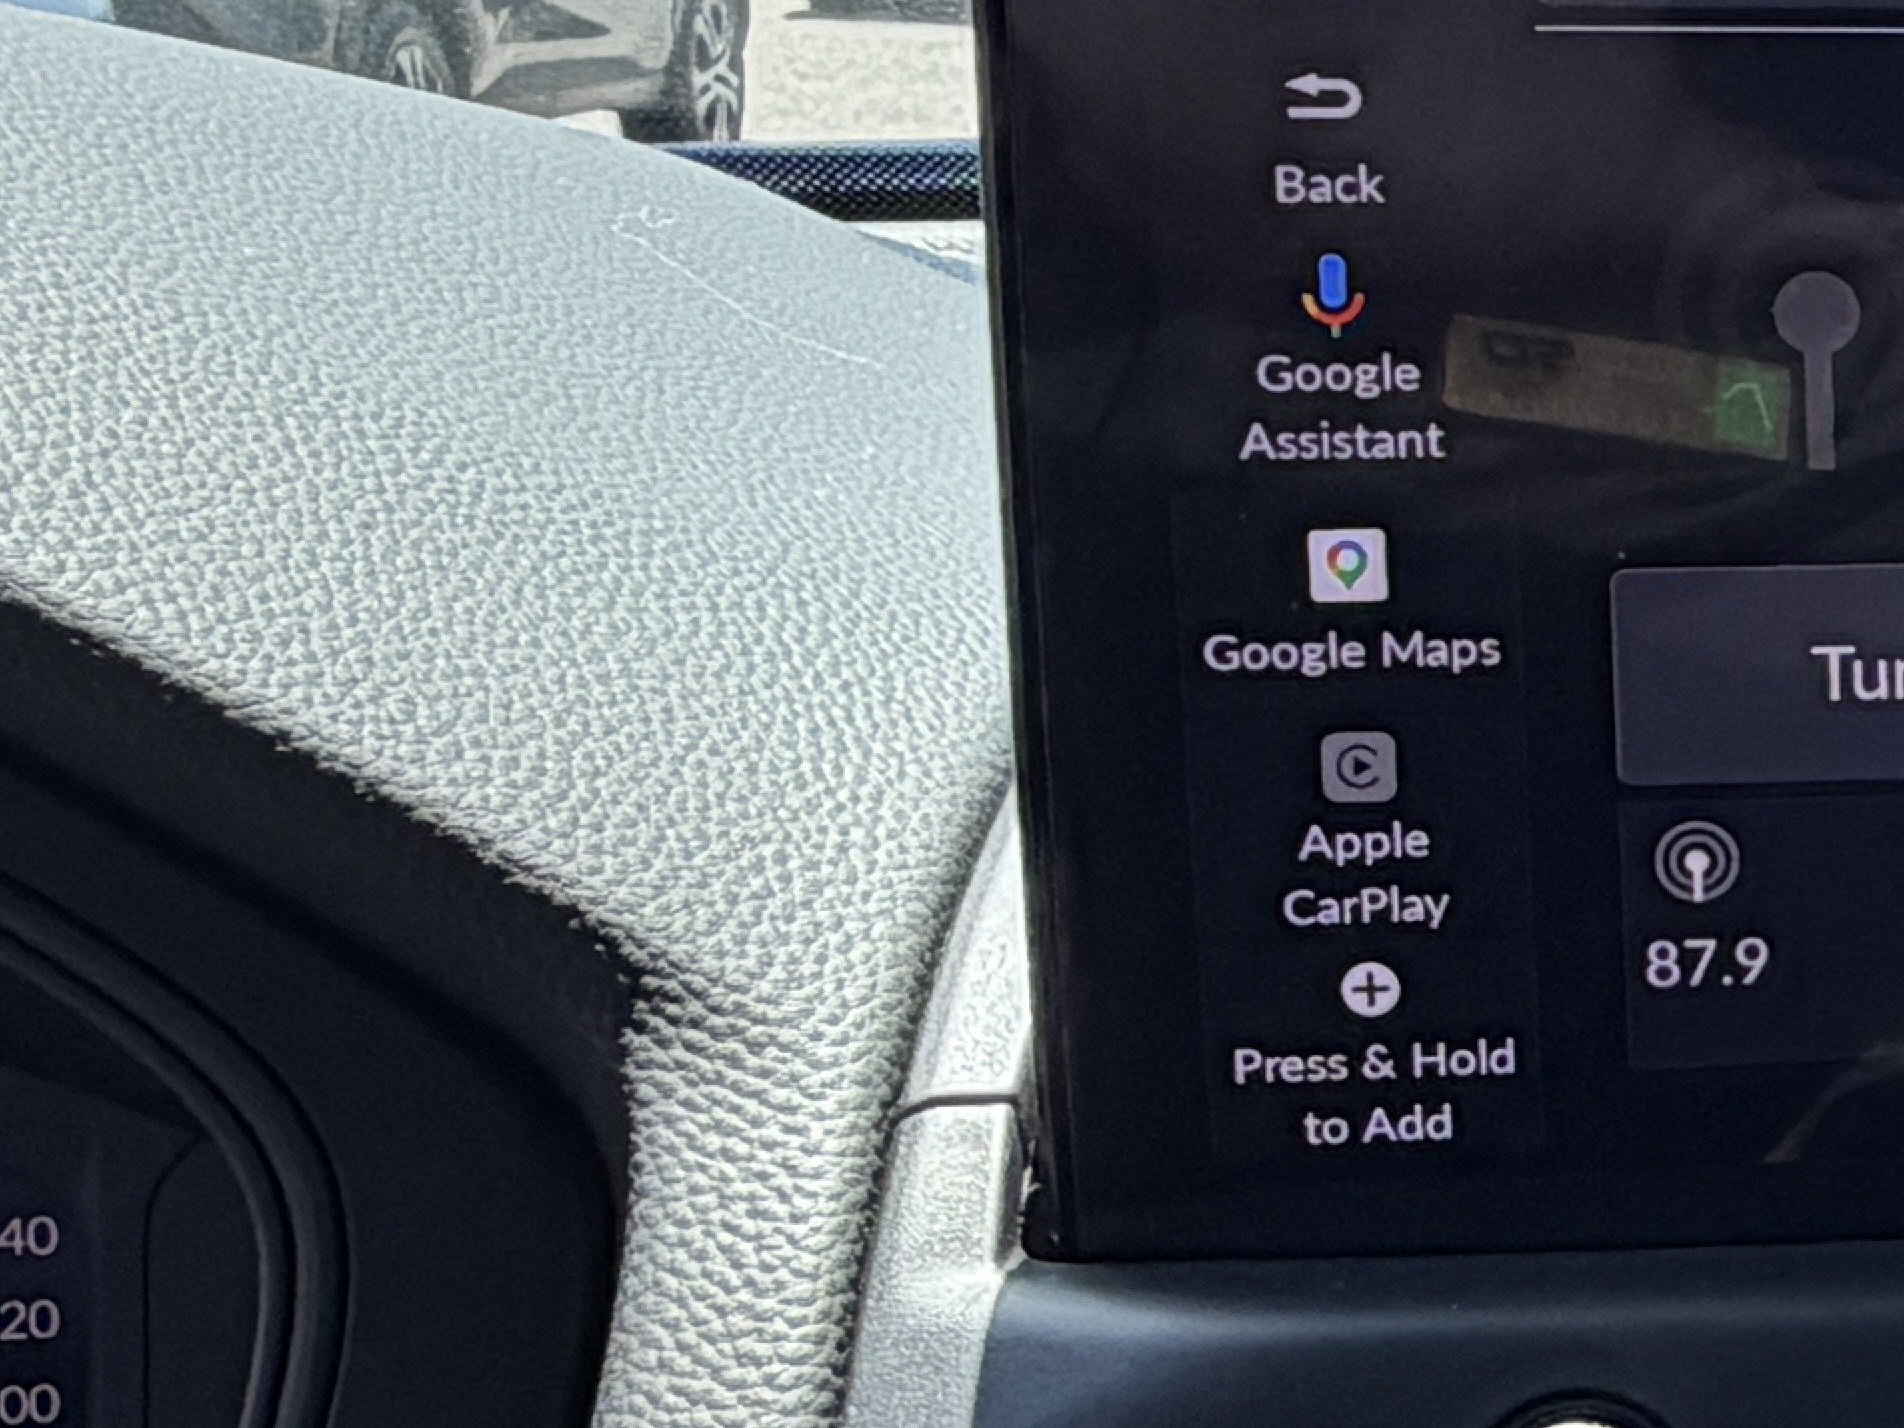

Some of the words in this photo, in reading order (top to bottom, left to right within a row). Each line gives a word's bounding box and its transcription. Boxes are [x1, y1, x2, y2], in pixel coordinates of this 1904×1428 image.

[1274, 162, 1385, 204] Back
[1256, 352, 1421, 400] Google
[1238, 420, 1446, 460] Assistant
[1202, 630, 1366, 678] Google
[1382, 630, 1502, 674] Maps
[1298, 820, 1430, 868] Apple
[1283, 884, 1450, 930] CarPlay
[1646, 936, 1769, 988] 87.9
[1234, 1048, 1348, 1085] Press
[1360, 1043, 1398, 1080] &
[1412, 1036, 1516, 1079] Hold
[1302, 1112, 1350, 1146] to
[1362, 1102, 1453, 1144] Add
